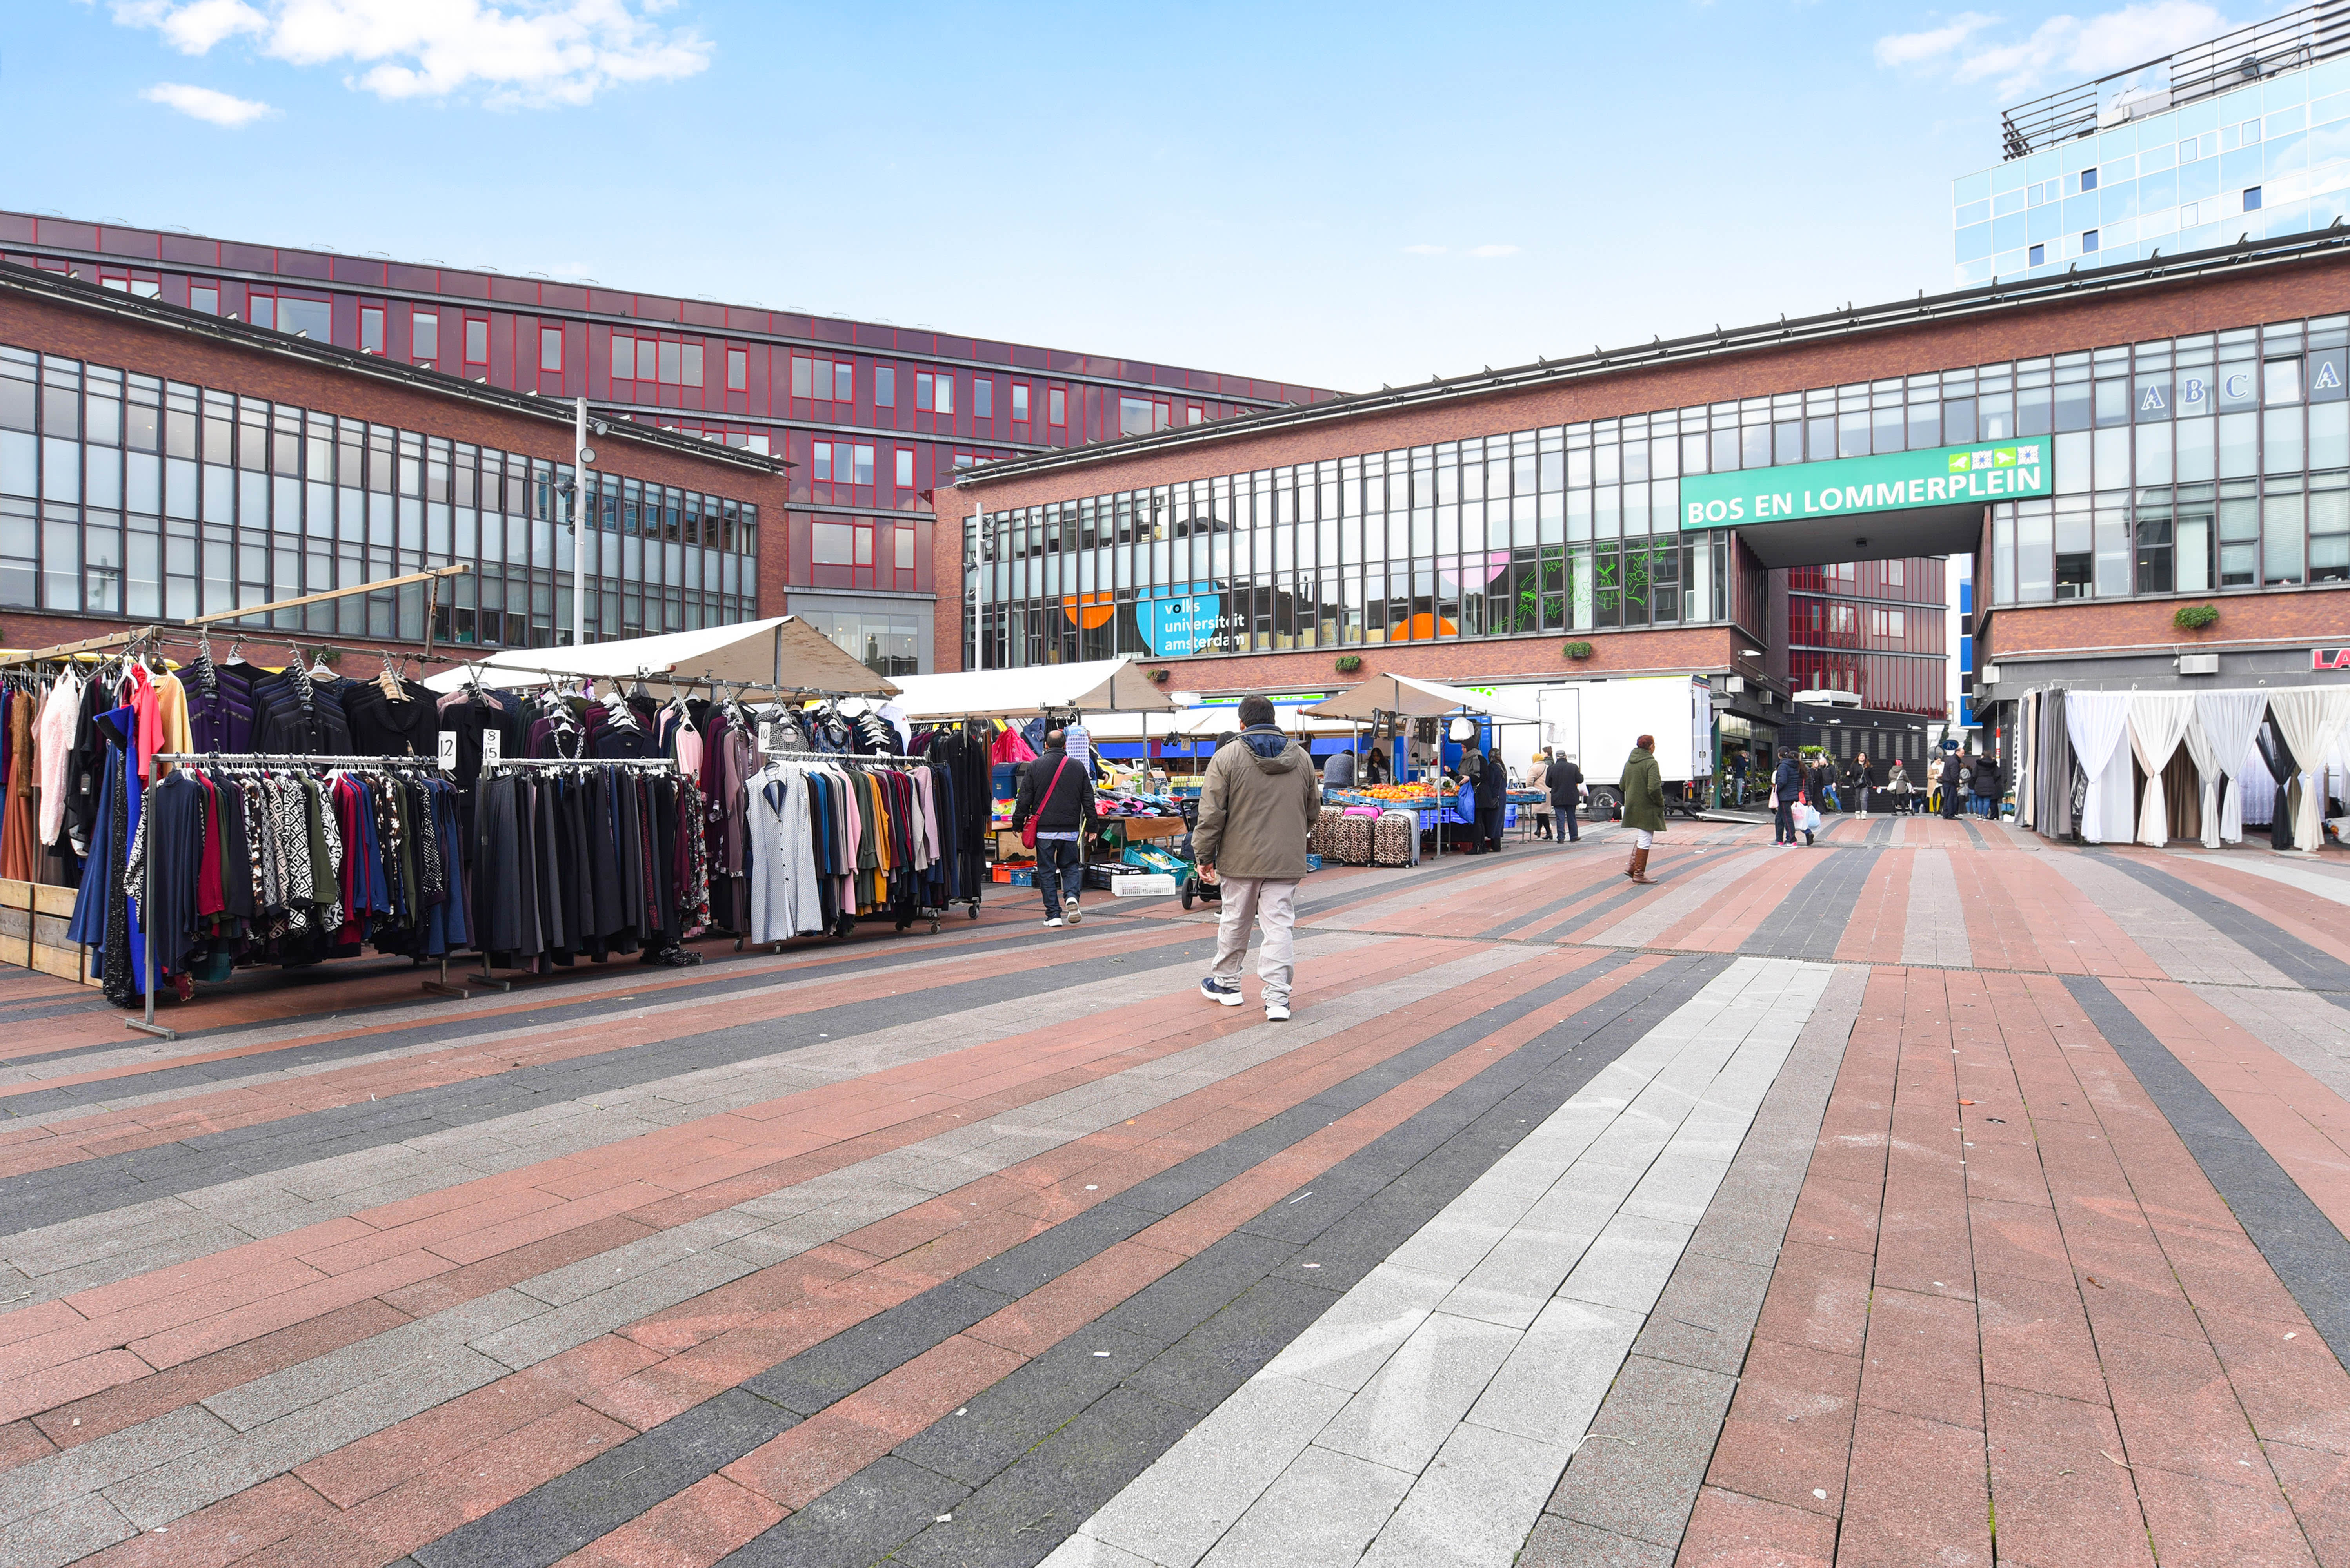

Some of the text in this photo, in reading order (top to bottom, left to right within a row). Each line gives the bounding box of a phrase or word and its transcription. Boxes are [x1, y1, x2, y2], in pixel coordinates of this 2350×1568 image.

[1688, 466, 2040, 524] BOS EN LOMMERPLEIN
[1165, 599, 1200, 614] volks
[1165, 632, 1245, 651] amsterdam
[487, 731, 496, 741] 8
[761, 729, 768, 740] 10
[440, 739, 453, 757] 12
[485, 747, 497, 759] 15
